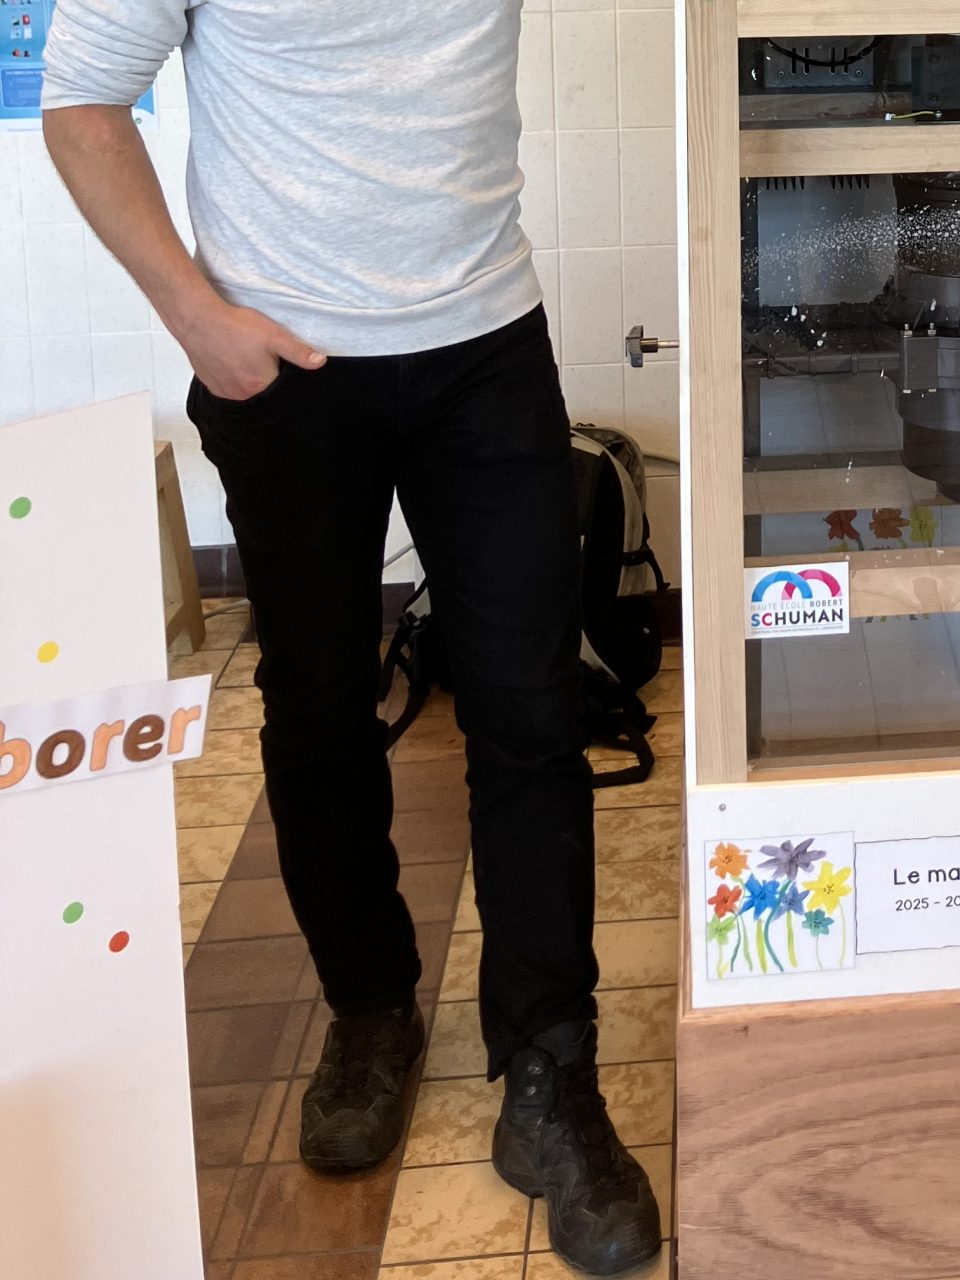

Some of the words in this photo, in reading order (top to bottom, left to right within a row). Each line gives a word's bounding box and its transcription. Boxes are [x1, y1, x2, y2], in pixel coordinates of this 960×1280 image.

[751, 602, 778, 611] HAUTE
[810, 599, 843, 607] ROBERT
[751, 608, 843, 627] SCHUMAN
[0, 705, 201, 791] borer
[894, 869, 920, 886] Le
[895, 897, 929, 911] 2025
